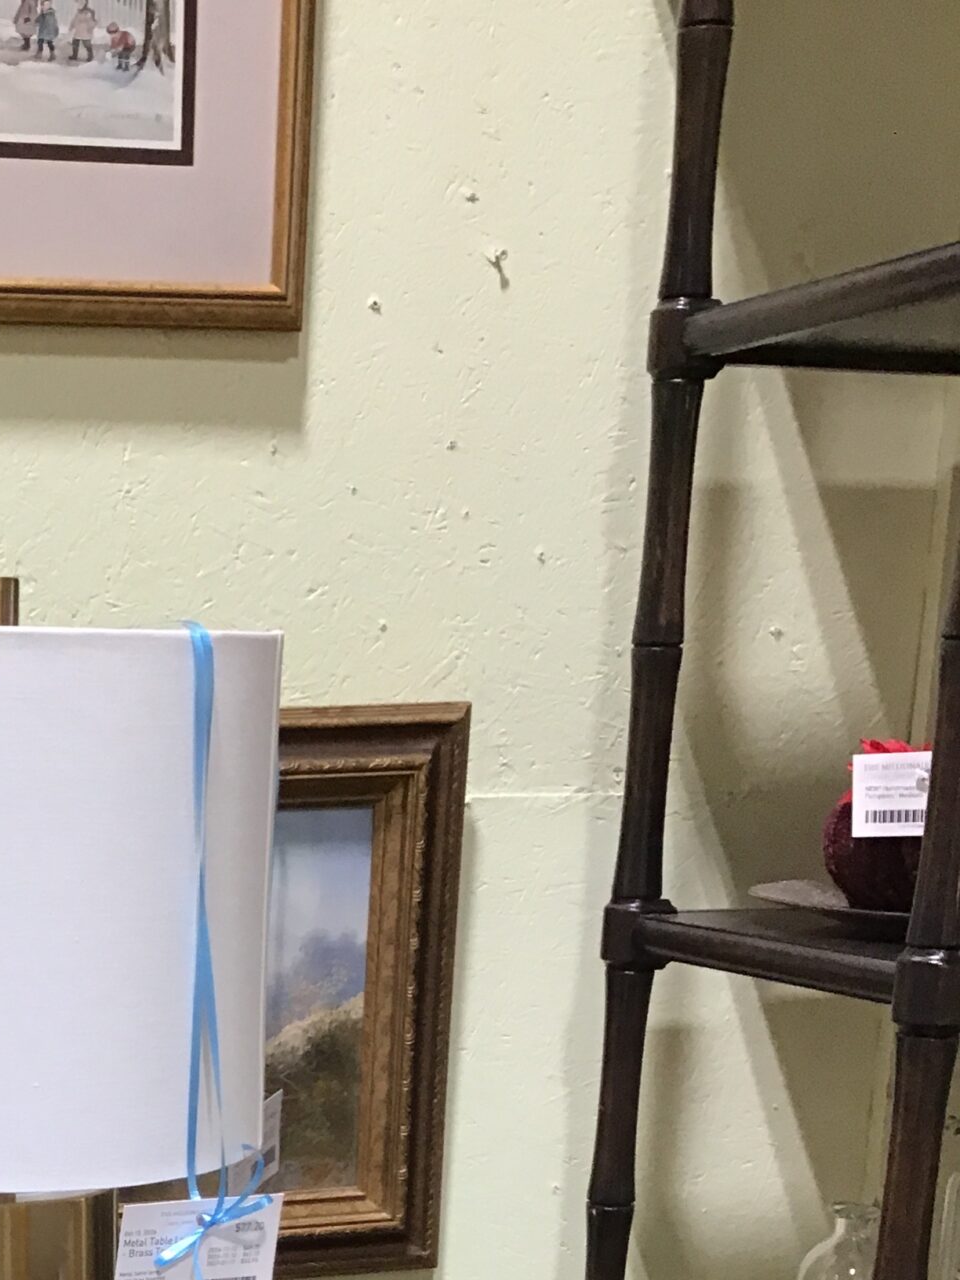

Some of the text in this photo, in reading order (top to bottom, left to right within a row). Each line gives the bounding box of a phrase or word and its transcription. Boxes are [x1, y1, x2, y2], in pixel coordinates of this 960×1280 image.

[123, 1236, 147, 1248] Metal
[150, 1235, 173, 1246] Table
[129, 1248, 153, 1258] Brass
